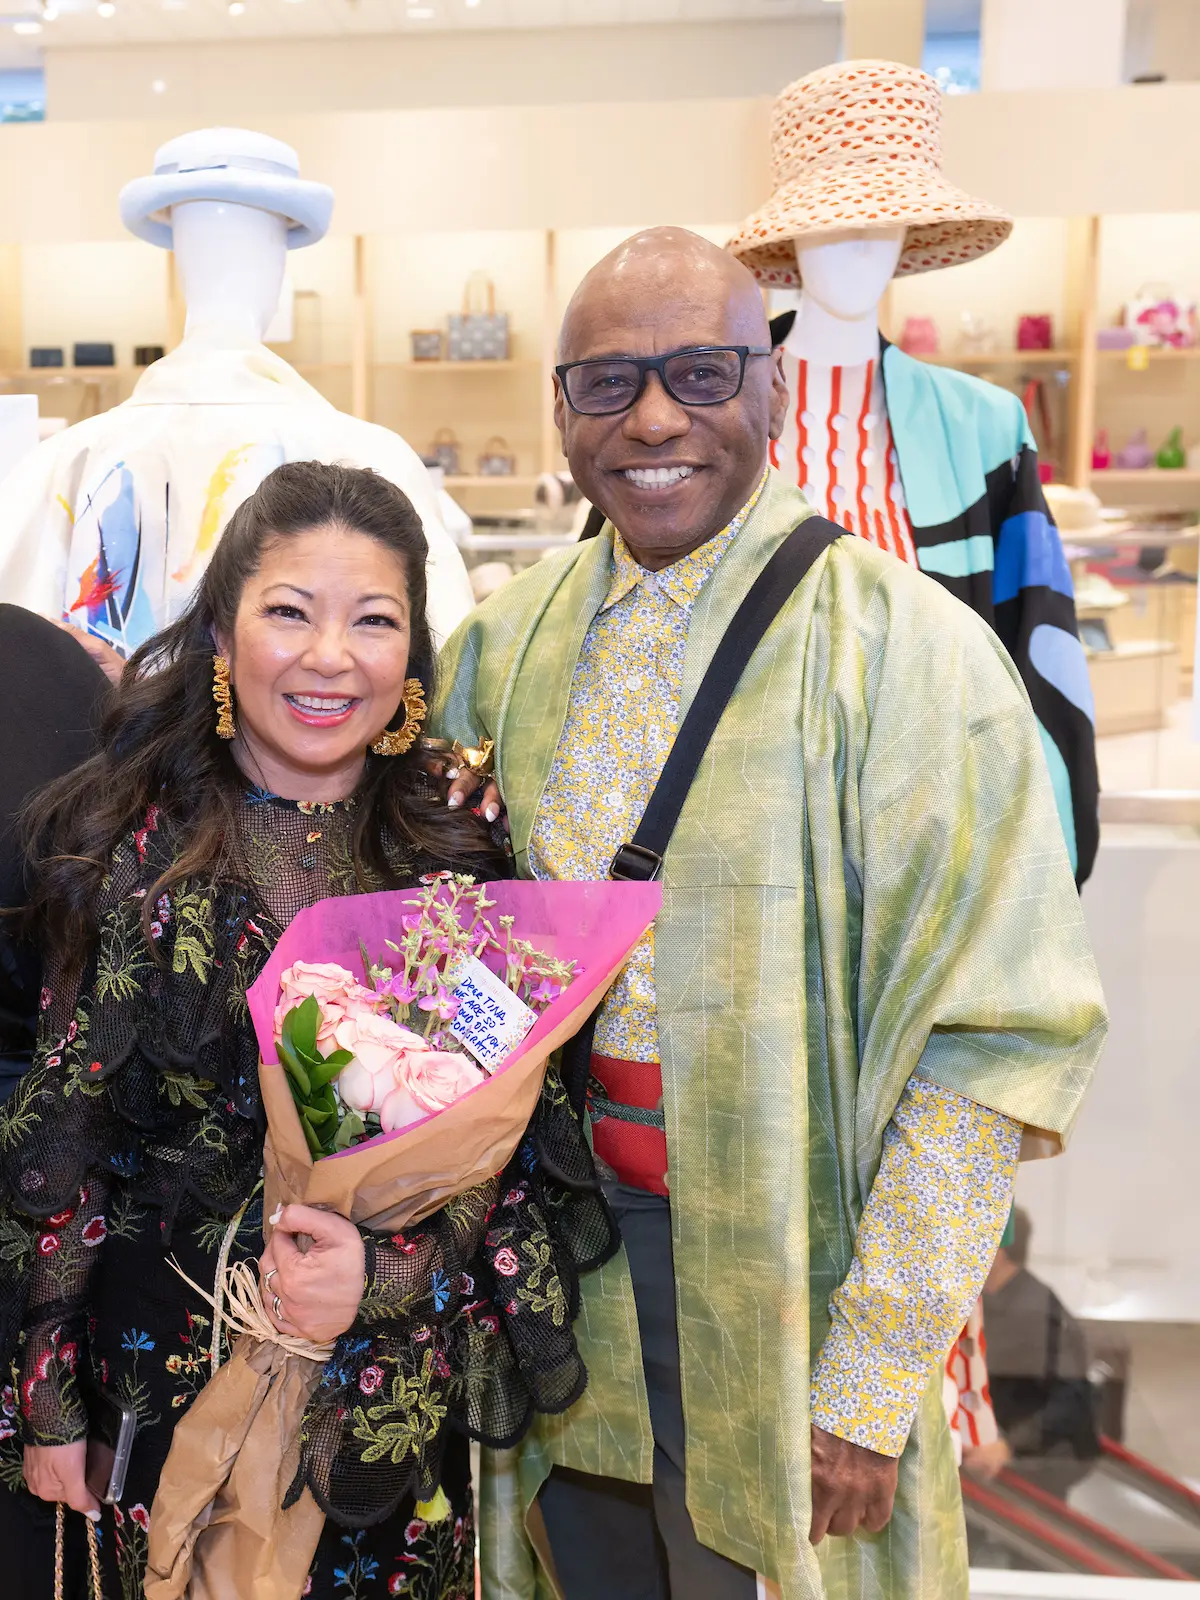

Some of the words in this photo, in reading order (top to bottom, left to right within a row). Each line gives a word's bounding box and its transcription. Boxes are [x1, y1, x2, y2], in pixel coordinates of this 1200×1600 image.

[450, 986, 470, 1001] WE
[465, 1000, 486, 1018] ARE
[483, 1016, 496, 1029] SO
[474, 1021, 488, 1033] OF
